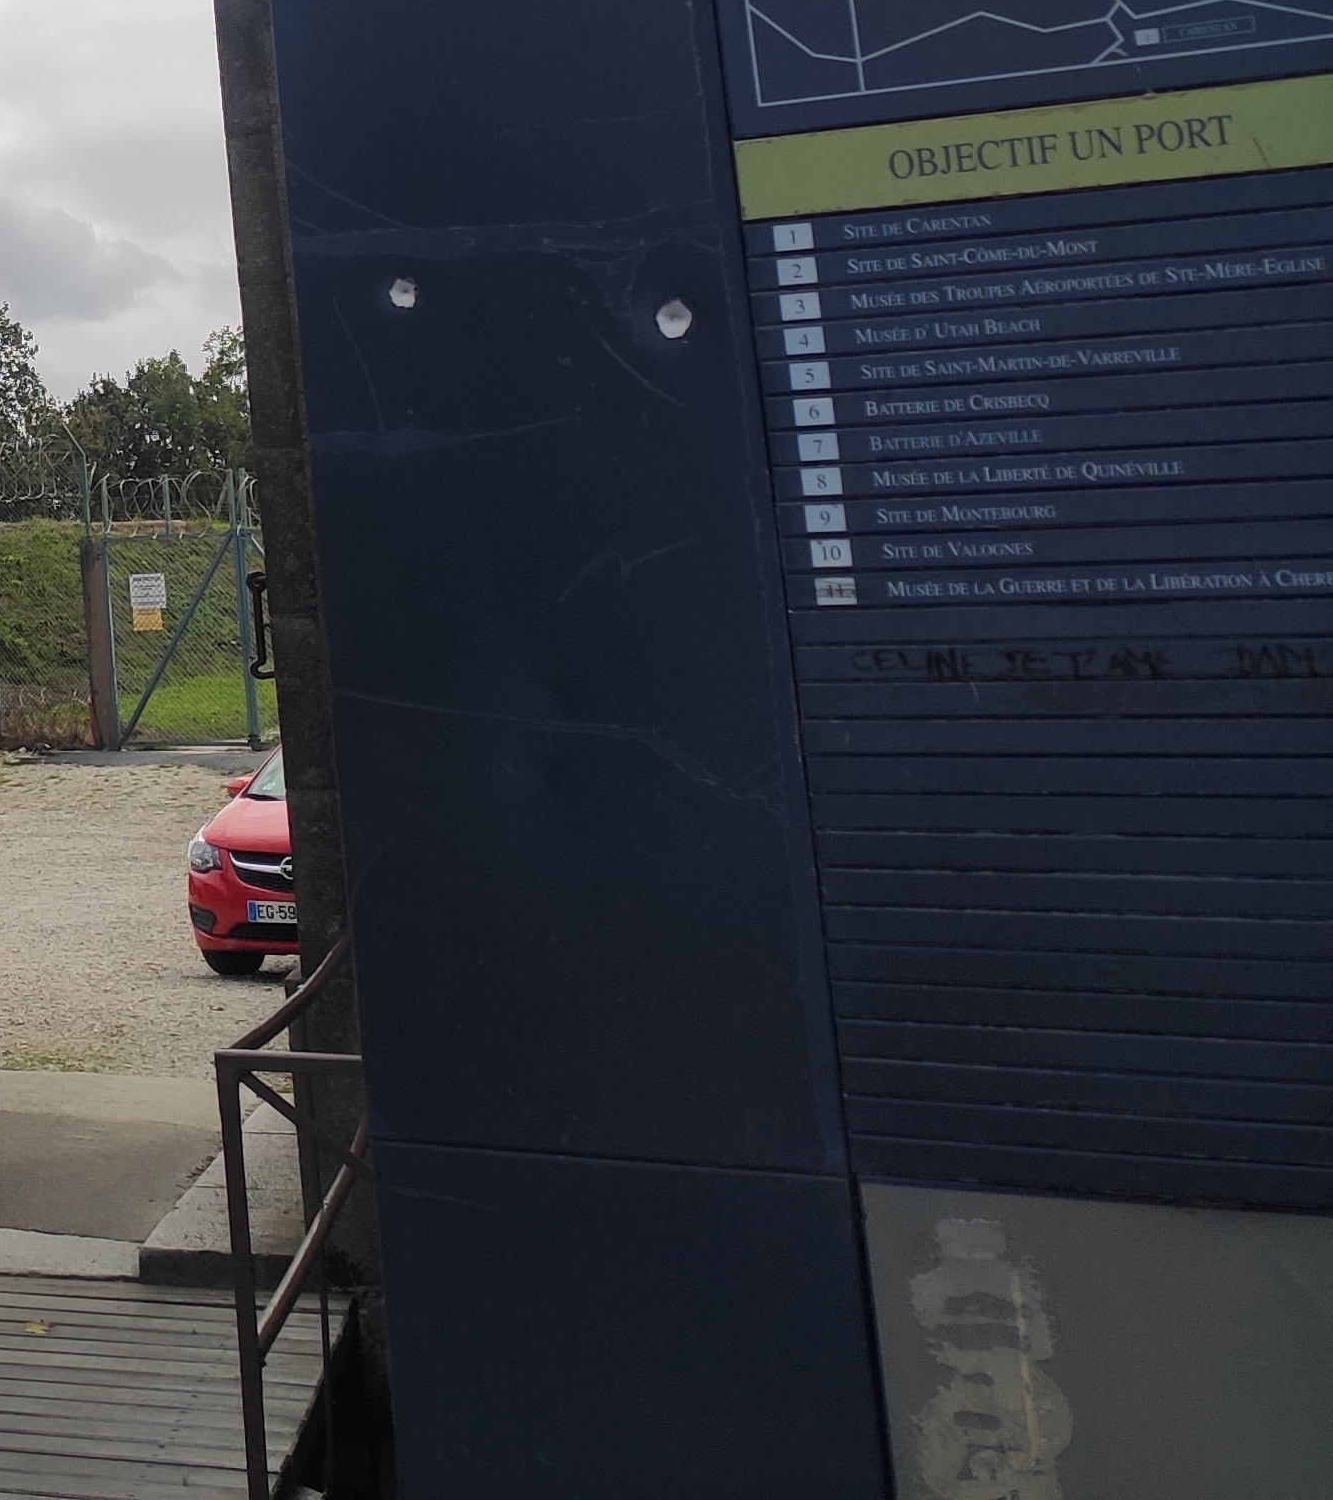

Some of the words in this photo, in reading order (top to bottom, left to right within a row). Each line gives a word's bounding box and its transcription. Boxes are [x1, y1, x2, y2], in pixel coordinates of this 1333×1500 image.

[888, 134, 1058, 179] OBJECTIF
[1068, 127, 1124, 161] UN
[1133, 115, 1233, 154] PORT
[789, 229, 797, 245] 1
[842, 224, 880, 240] SITE
[883, 222, 903, 237] DE
[906, 214, 992, 235] CARENTAN
[791, 264, 803, 279] 2
[846, 257, 883, 275] SITE
[885, 256, 906, 271] DE
[795, 298, 806, 315] 3
[849, 289, 906, 310] MUSÉE
[908, 289, 941, 305] DES
[944, 282, 1016, 302] TROUPES
[1137, 269, 1163, 286] DE
[798, 333, 810, 348] 4
[934, 321, 981, 339] UTAH
[982, 317, 1042, 336] BEACH
[804, 367, 815, 384] 5
[859, 363, 897, 381] SITE
[899, 363, 922, 378] DE
[925, 346, 1182, 376] SAINT-MARTIN-DE-VARREVILLE
[809, 404, 821, 420] 6
[864, 399, 940, 417] BATTERIE
[942, 398, 965, 412] DE
[968, 393, 1051, 411] CRISBECQ
[812, 439, 823, 455] 7
[869, 434, 944, 452] BATTERIE
[816, 473, 827, 490] 8
[932, 471, 955, 485] DE
[957, 469, 980, 483] LA
[983, 463, 1052, 483] LIBERTÉ
[1054, 465, 1078, 479] DE
[819, 510, 831, 526] 9
[876, 507, 913, 525] SITE
[916, 509, 938, 523] DE
[940, 504, 1057, 523] MONTEBOURG
[820, 544, 842, 561] 10
[882, 542, 918, 560] SITE
[922, 544, 944, 558] DE
[946, 541, 1034, 558] VALOGNES
[949, 581, 971, 596] DE
[973, 580, 996, 595] LA
[998, 576, 1067, 595] GUERRE
[1070, 578, 1091, 592] ET
[1095, 576, 1118, 591] DE
[1122, 575, 1146, 591] LA
[1149, 570, 1254, 591] LIBÉRATION
